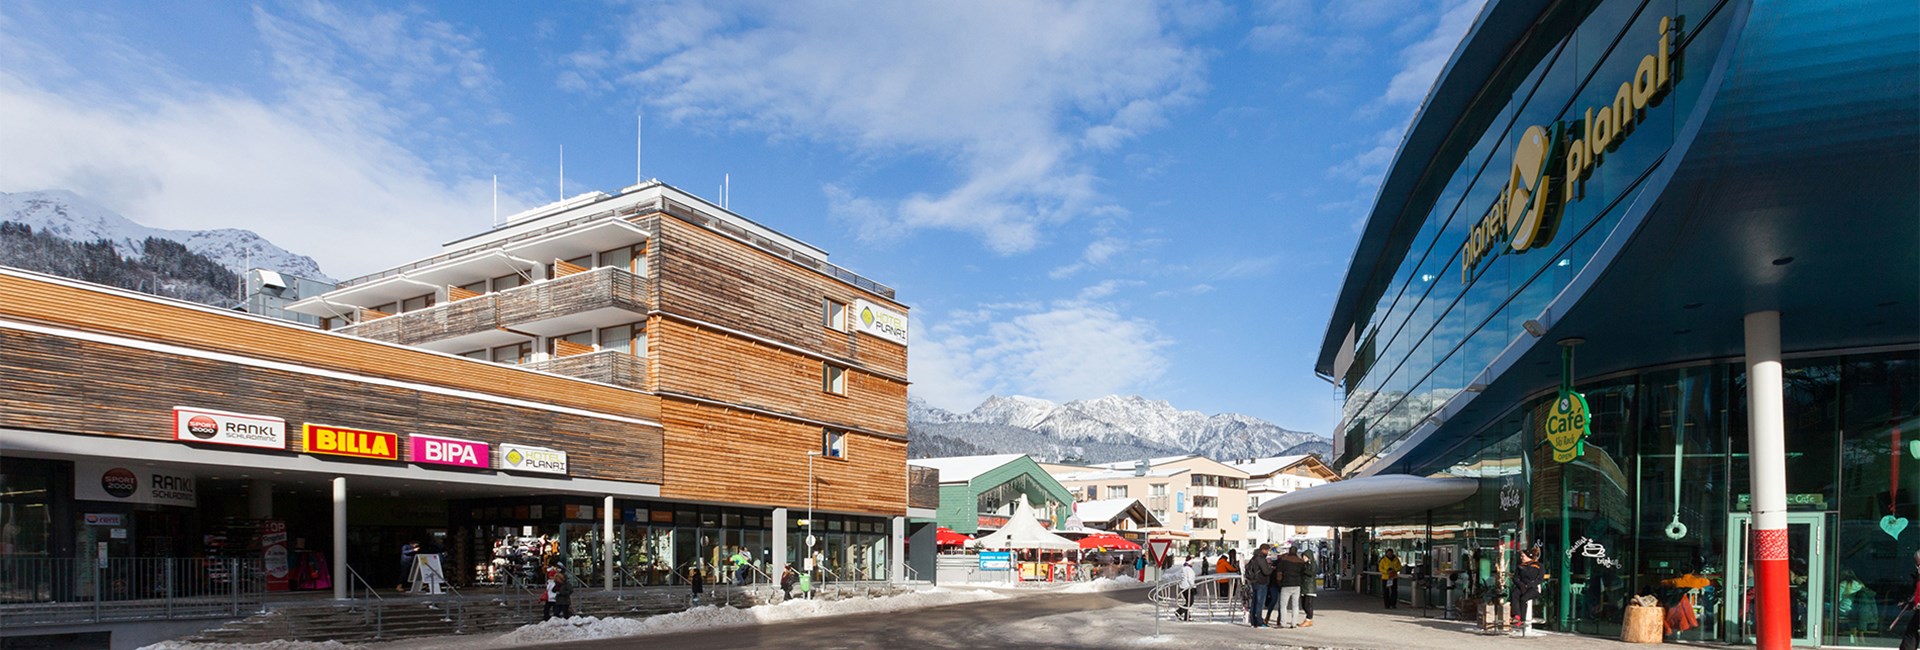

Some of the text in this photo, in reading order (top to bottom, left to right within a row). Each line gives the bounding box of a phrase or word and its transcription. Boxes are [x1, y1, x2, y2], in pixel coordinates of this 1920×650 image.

[1566, 15, 1669, 203] planai
[875, 310, 905, 330] HOTEL
[875, 320, 906, 340] PLANAI
[189, 421, 217, 429] SPORT
[1548, 407, 1584, 435] Café
[226, 422, 277, 437] RANKL
[226, 432, 277, 443] SCHLADMING
[316, 429, 390, 456] BILLA
[425, 440, 478, 465] BIPA
[525, 450, 561, 462] HOTEL
[525, 459, 565, 471] PLANAI
[104, 475, 135, 484] SPORT
[107, 482, 133, 490] 2000
